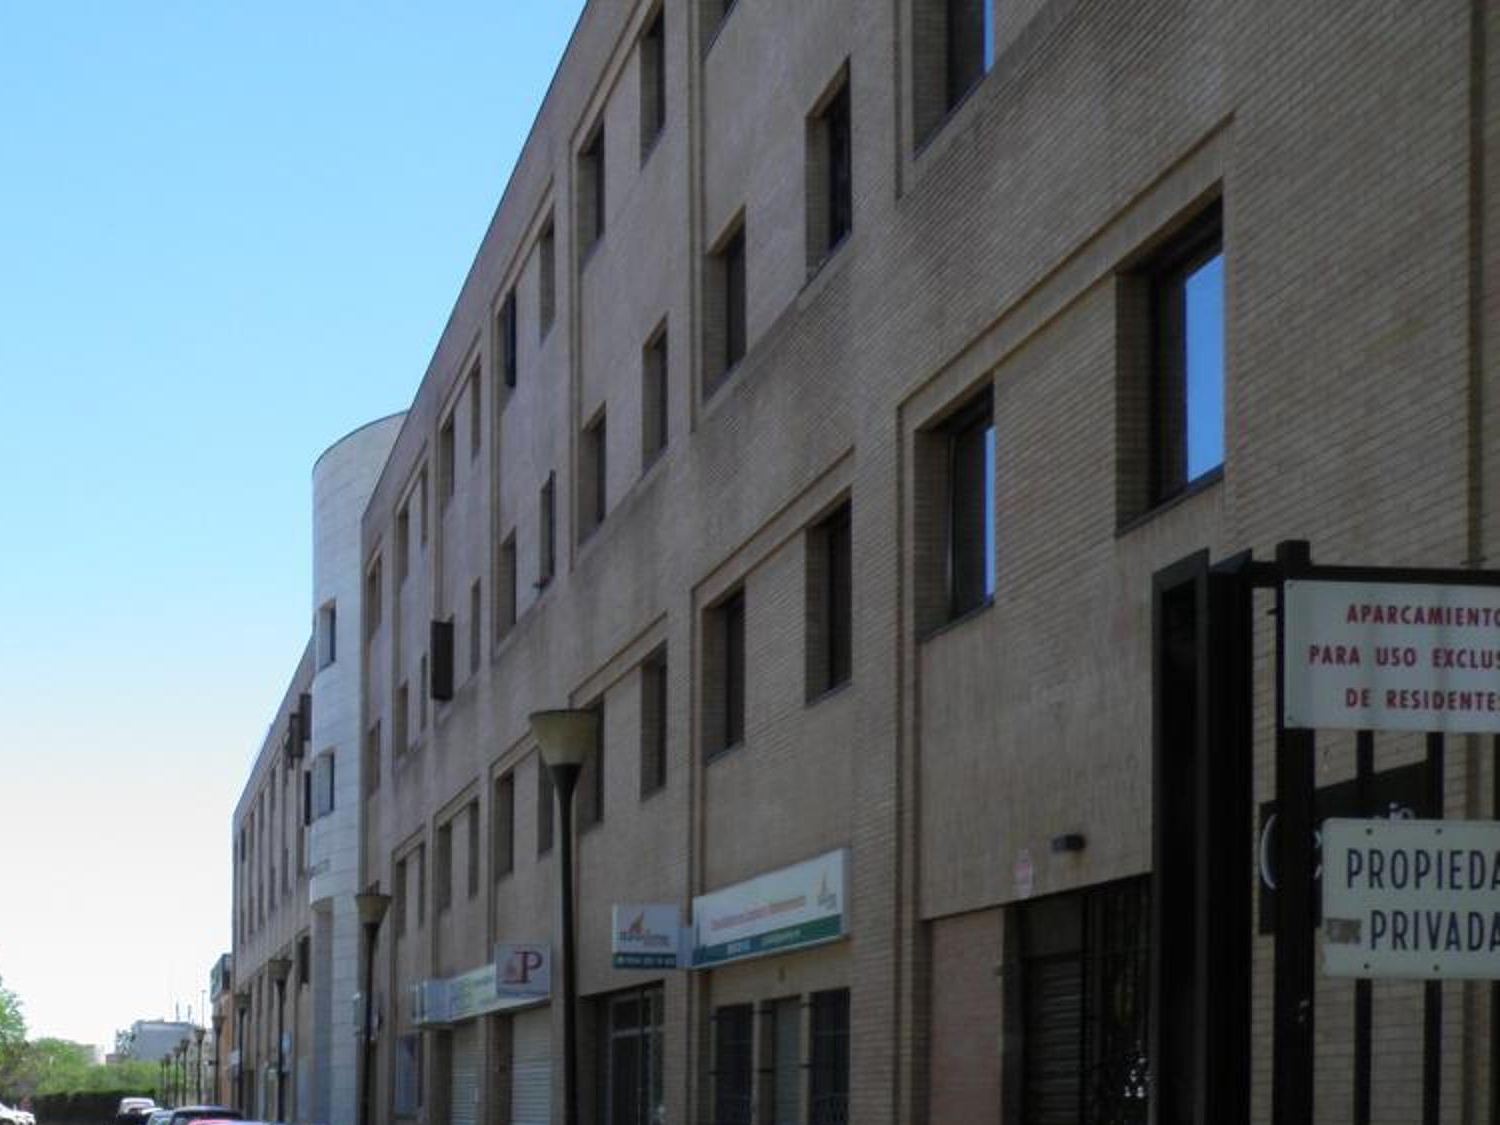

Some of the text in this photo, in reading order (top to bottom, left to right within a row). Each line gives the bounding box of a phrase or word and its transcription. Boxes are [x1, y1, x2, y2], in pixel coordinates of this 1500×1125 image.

[1309, 645, 1360, 666] PARA
[1376, 648, 1416, 667] USO
[1345, 688, 1500, 711] DE RESIDENTE
